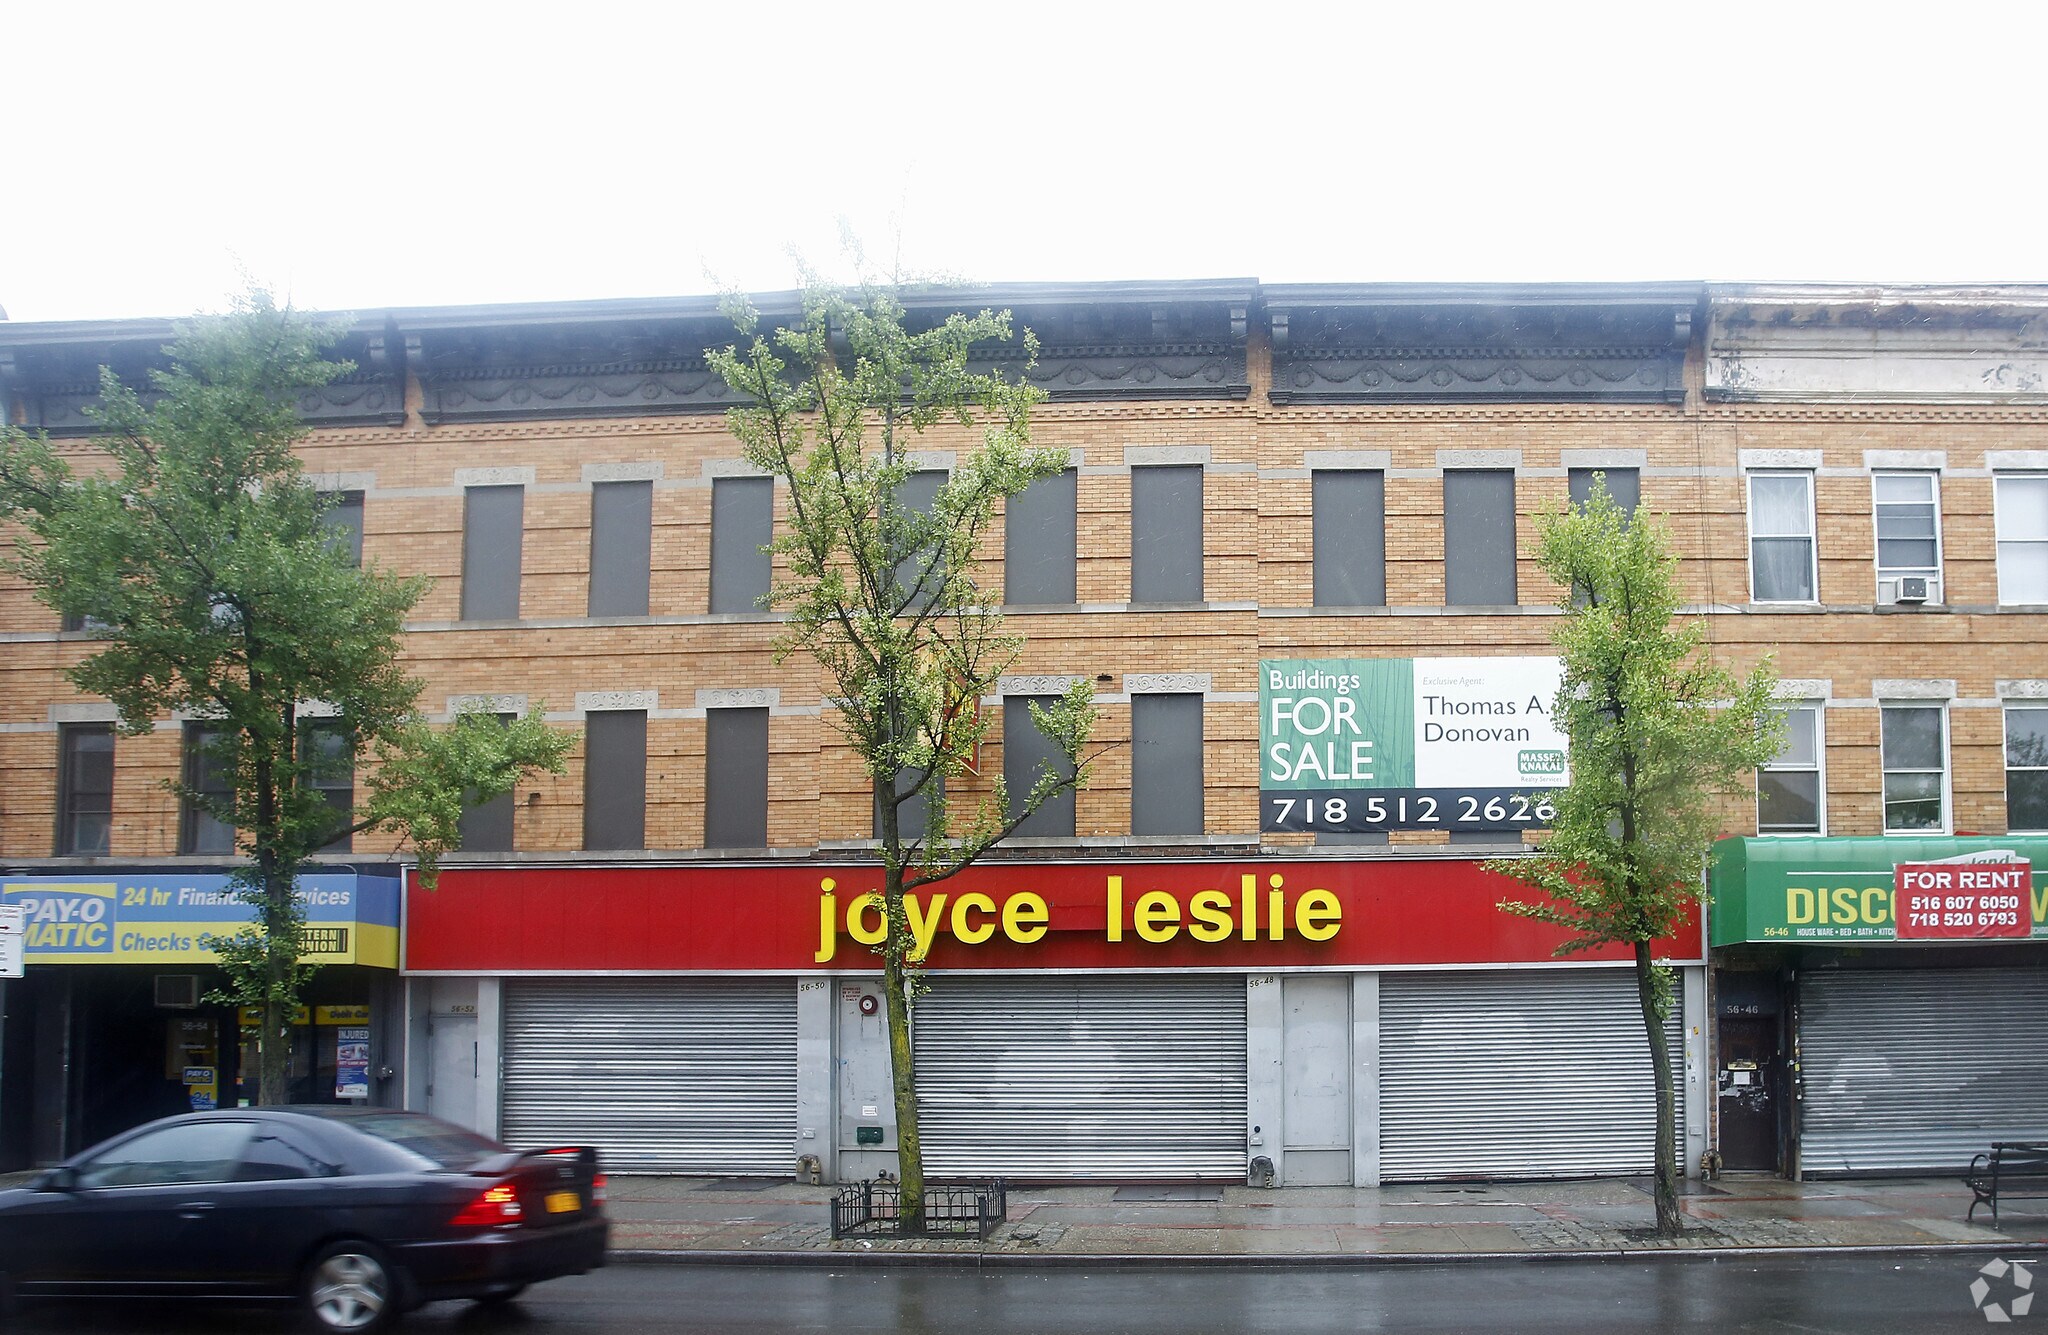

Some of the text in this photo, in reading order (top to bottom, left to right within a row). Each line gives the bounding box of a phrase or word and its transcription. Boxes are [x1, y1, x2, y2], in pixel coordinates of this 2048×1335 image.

[1269, 669, 1361, 695] Buildings
[1422, 676, 1485, 688] Exclusive Agent:
[1422, 695, 1550, 715] Thomas A.
[1271, 696, 1363, 736] FOR
[1424, 722, 1530, 742] Donovan
[1270, 741, 1374, 782] SALE
[1520, 761, 1563, 772] KNAKAL
[1272, 796, 1556, 824] 718 512 2626
[1903, 871, 2024, 889] FOR RENT
[122, 887, 147, 906] 24
[151, 887, 172, 906] hr
[1911, 895, 2019, 910] 516 607 6050
[20, 898, 106, 923] PAY-O
[814, 873, 1342, 963] joyce leslie
[1909, 911, 2018, 927] 718 520 6793
[1764, 927, 1789, 937] 56-46
[1796, 928, 1817, 937] HOUSE
[1817, 928, 1835, 937] WARE
[1839, 928, 1852, 936] BED
[1857, 928, 1873, 936] BATH
[121, 932, 191, 951] Checks
[800, 981, 825, 992] 56-50
[1249, 976, 1274, 988] 56-48
[451, 1005, 475, 1013] 56-52
[1727, 1005, 1759, 1014] 56-46
